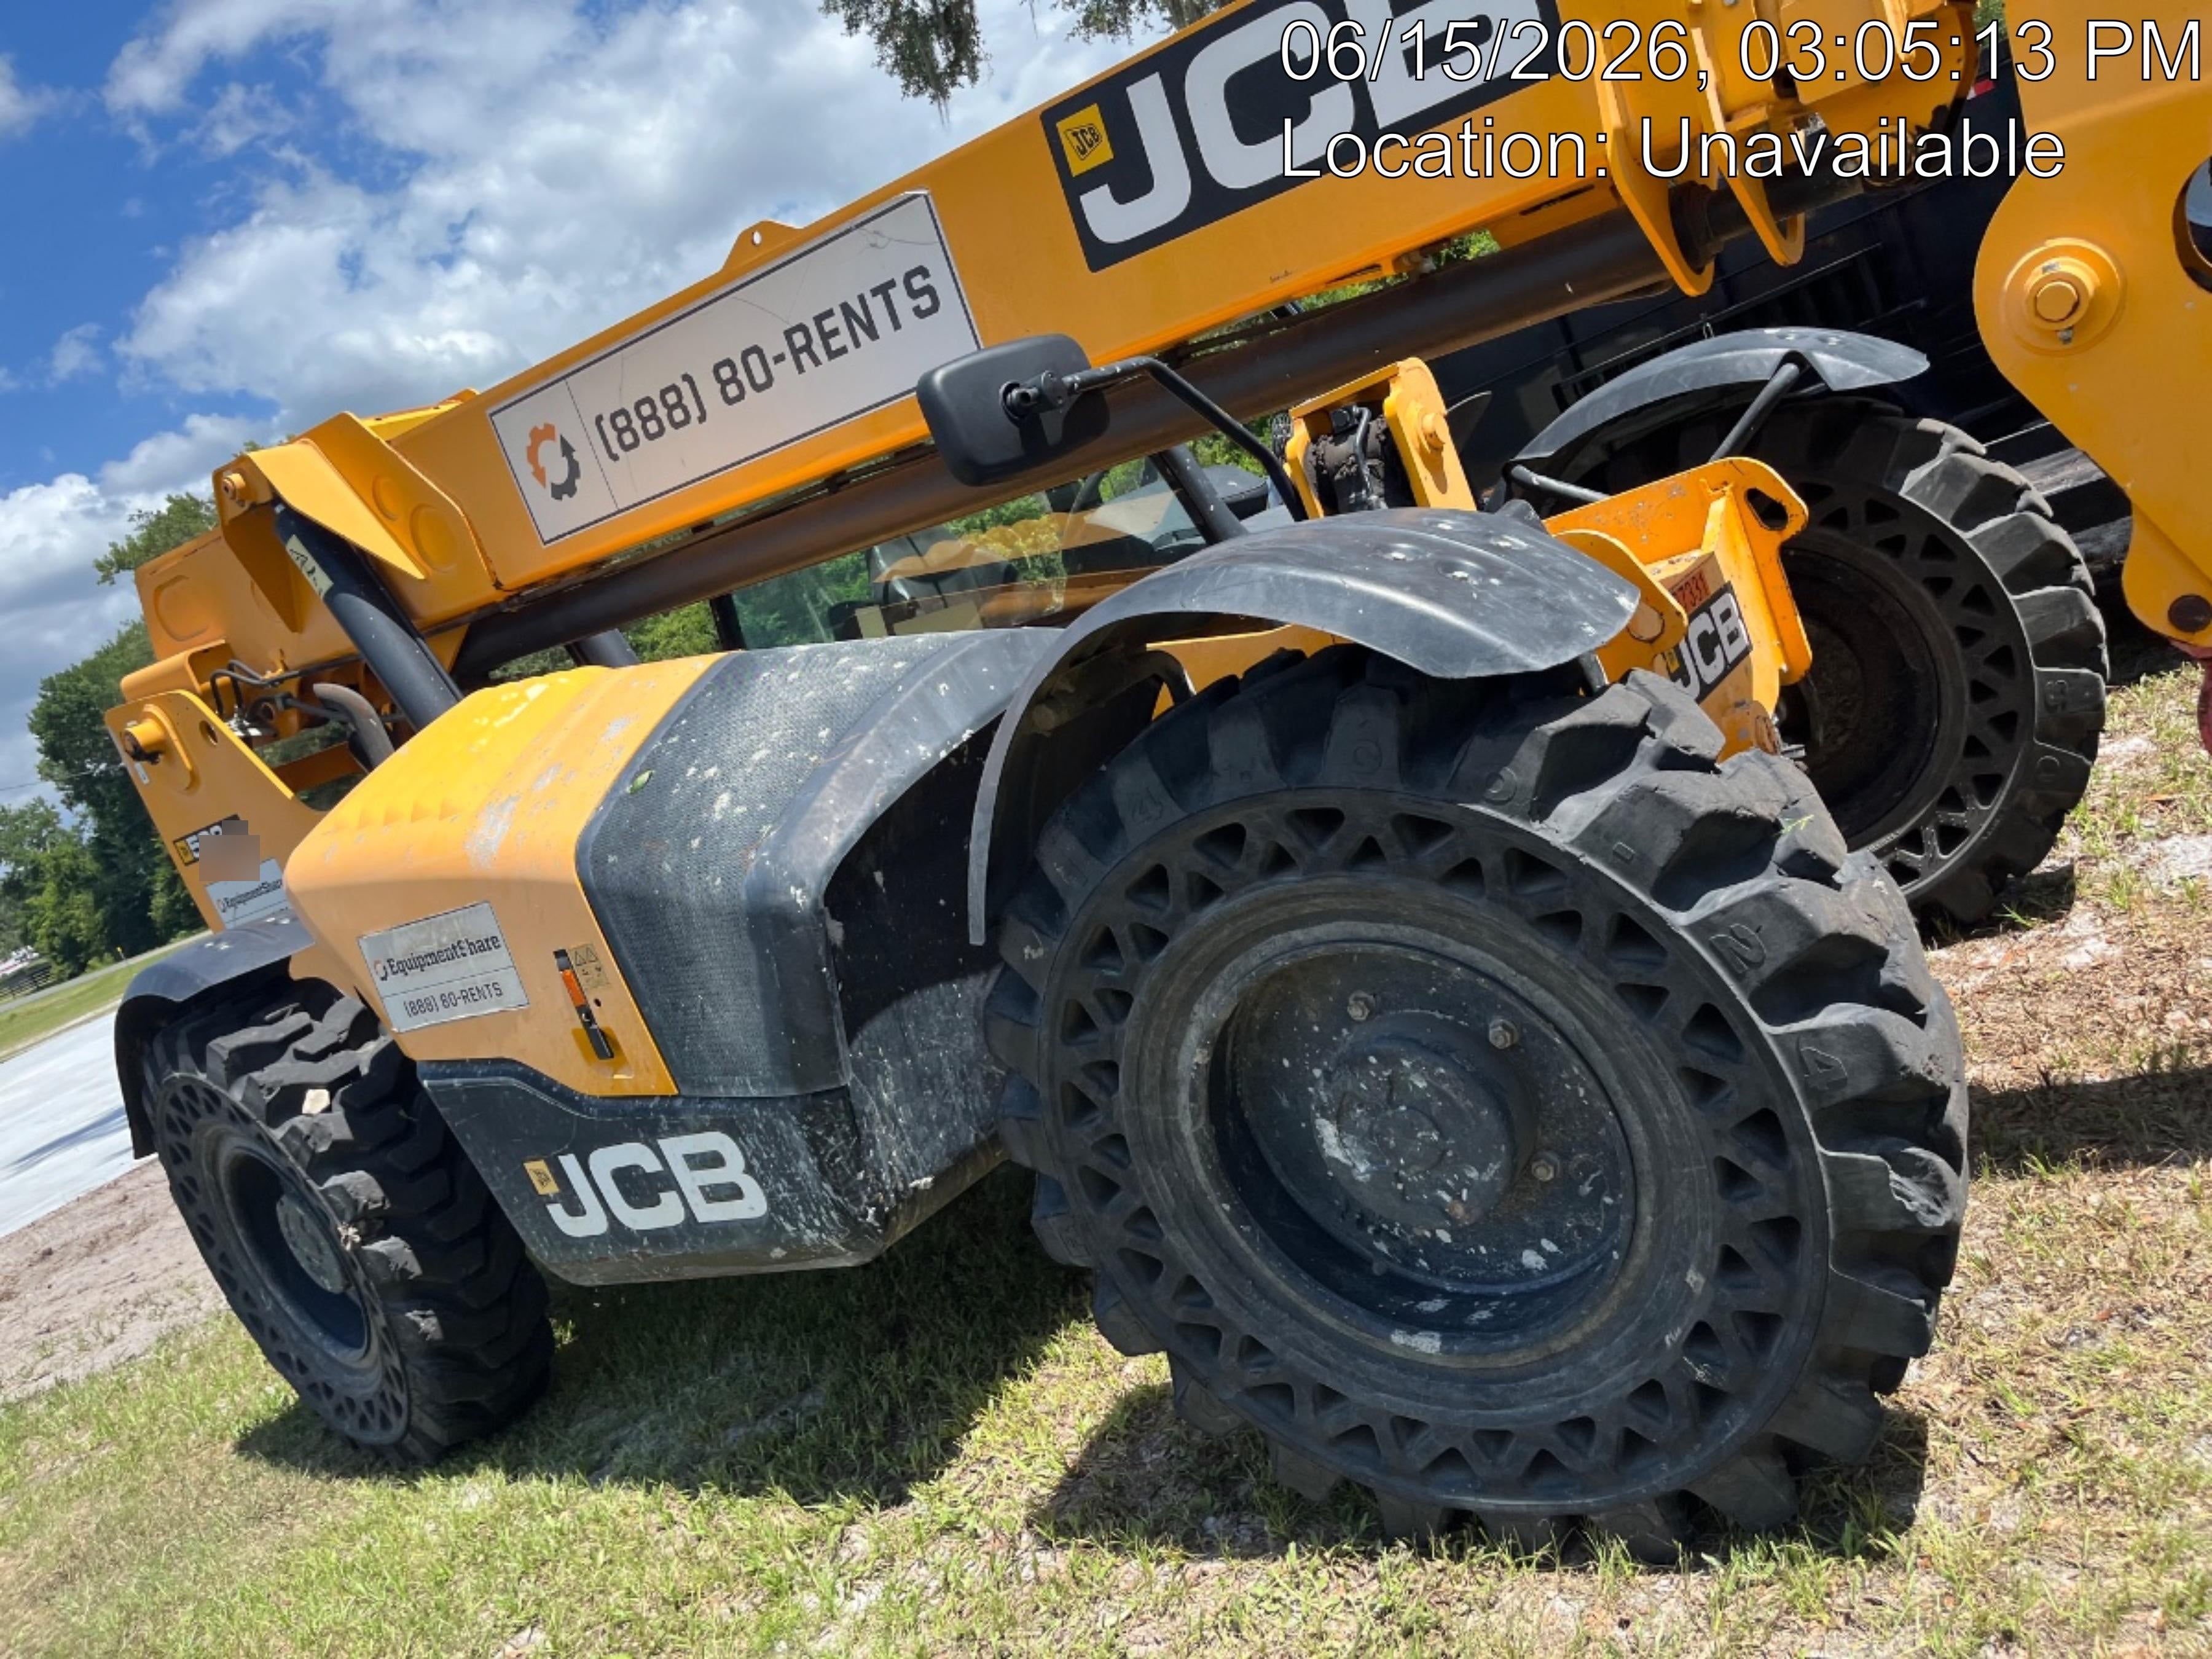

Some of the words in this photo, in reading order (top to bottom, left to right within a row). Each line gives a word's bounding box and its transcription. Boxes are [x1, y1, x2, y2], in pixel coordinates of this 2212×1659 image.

[1072, 127, 1099, 155] JCB
[595, 373, 707, 461] (888)
[713, 265, 941, 406] 80-RENTS
[1676, 593, 1750, 697] JCB
[386, 934, 501, 976] EquipmentShare
[403, 997, 440, 1018] (888)
[545, 1131, 768, 1237] JCB
